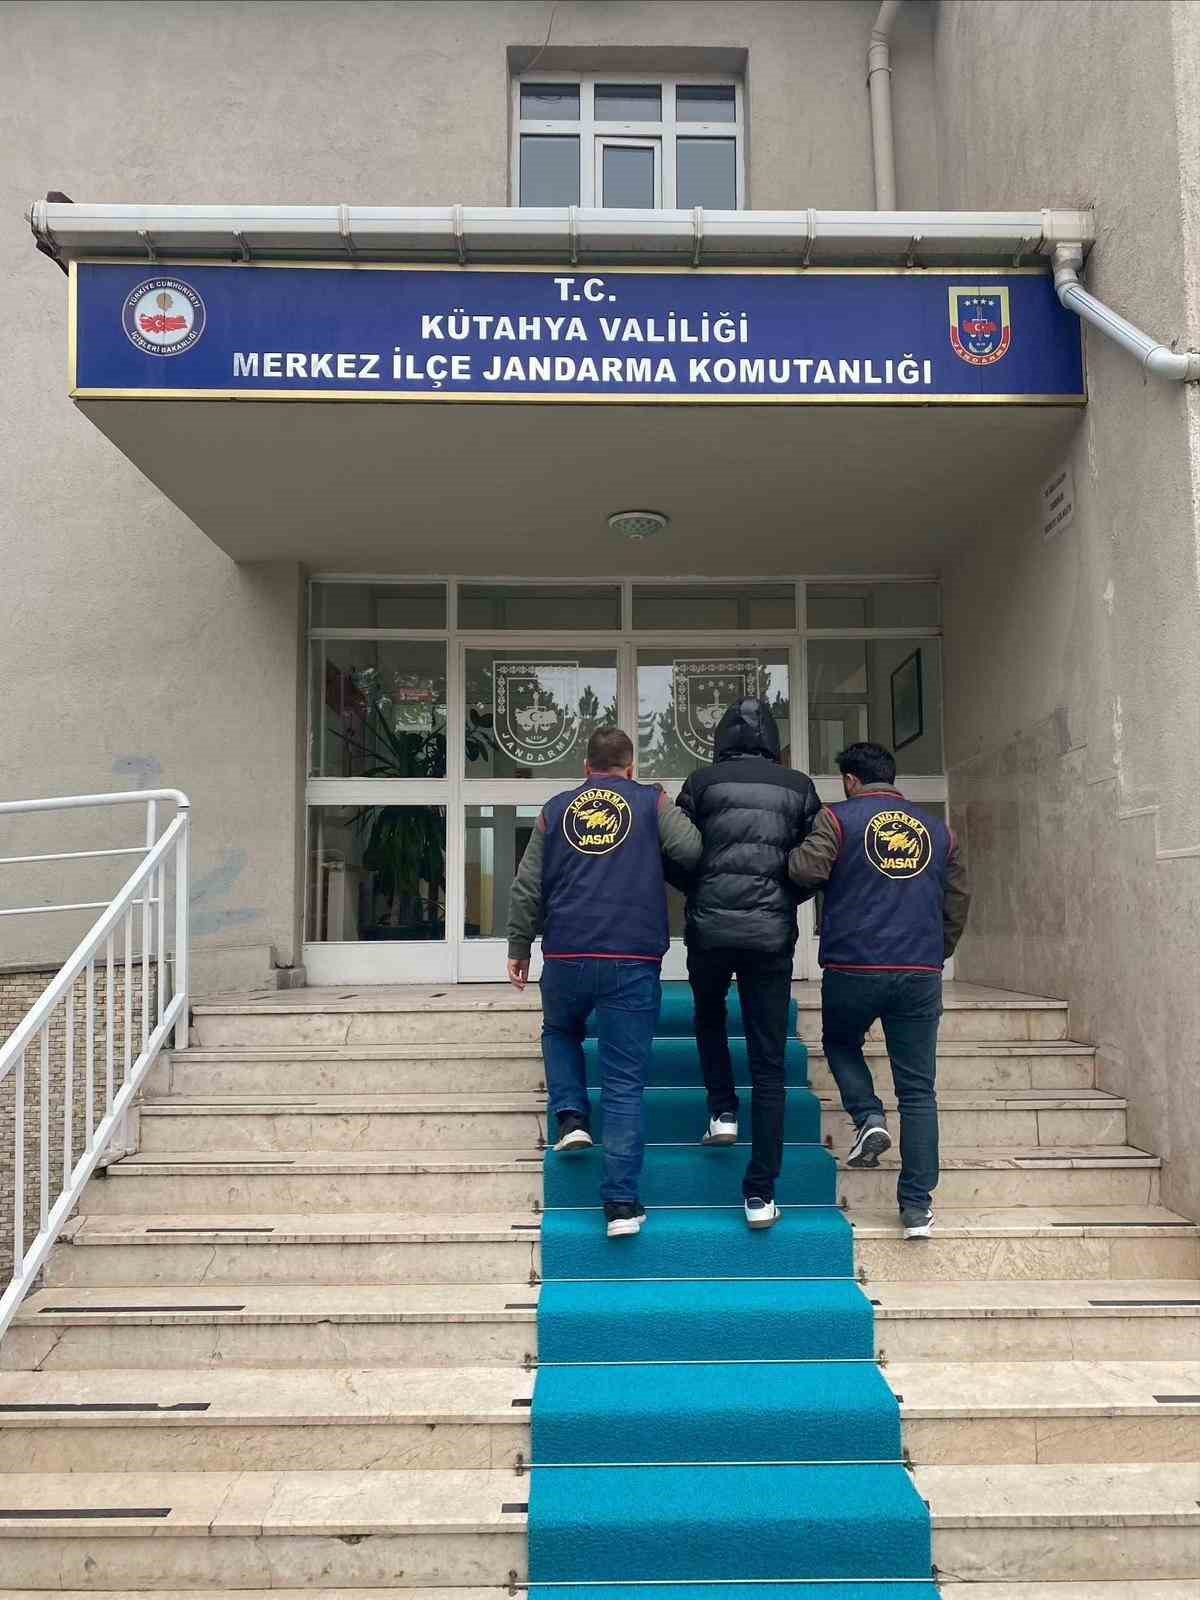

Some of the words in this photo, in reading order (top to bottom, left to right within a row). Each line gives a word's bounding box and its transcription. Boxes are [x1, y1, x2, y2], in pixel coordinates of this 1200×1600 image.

[553, 277, 617, 302] T.C.
[421, 308, 588, 341] KÜTAHYA
[599, 311, 749, 344] VALİLİĞİ
[232, 352, 381, 379] MERKEZ
[392, 346, 472, 388] İLÇE
[482, 355, 677, 383] JANDARMA
[689, 352, 933, 385] KOMUTANLIĞI
[570, 791, 626, 814] JANDARMA
[870, 812, 925, 835] JANDARMA
[578, 834, 616, 847] JASAT
[880, 857, 920, 870] JASAT
